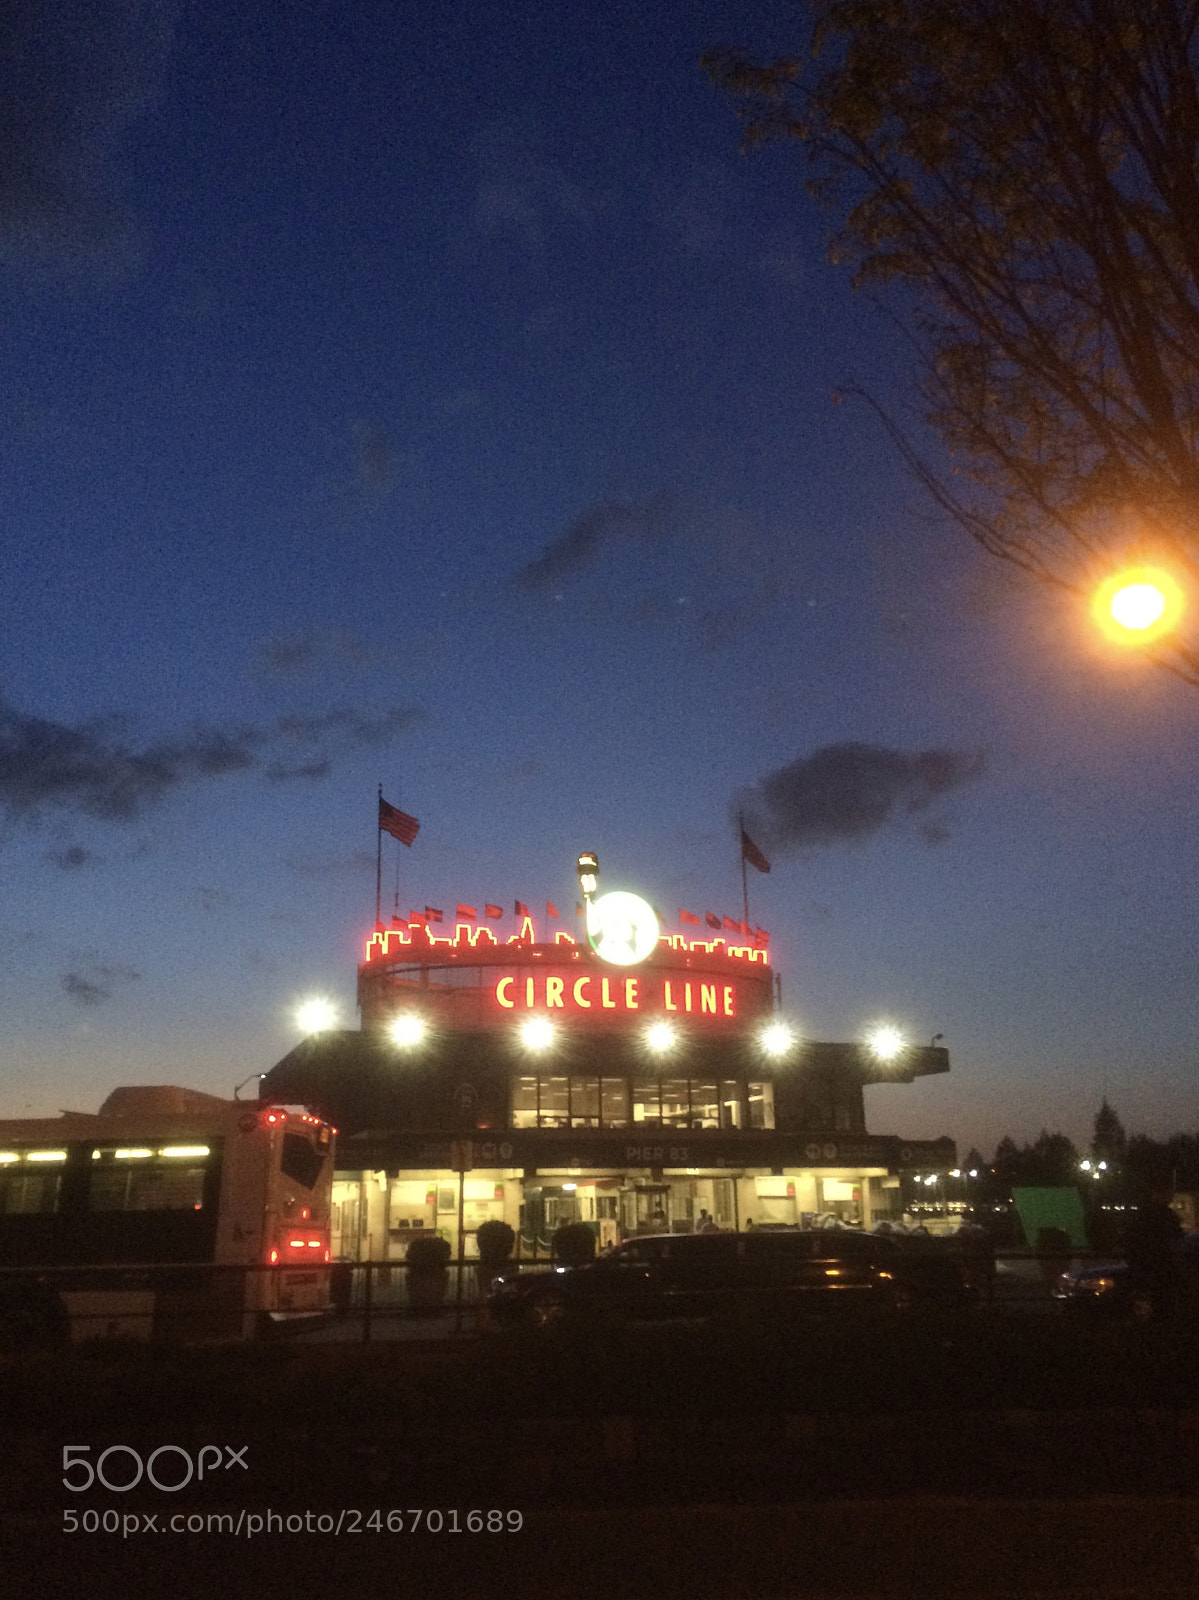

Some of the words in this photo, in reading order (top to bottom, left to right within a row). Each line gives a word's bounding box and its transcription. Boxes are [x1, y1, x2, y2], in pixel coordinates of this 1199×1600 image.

[496, 976, 639, 1010] CIRCLE
[665, 982, 735, 1016] LINE
[626, 1145, 664, 1161] PIER
[668, 1146, 689, 1161] 83
